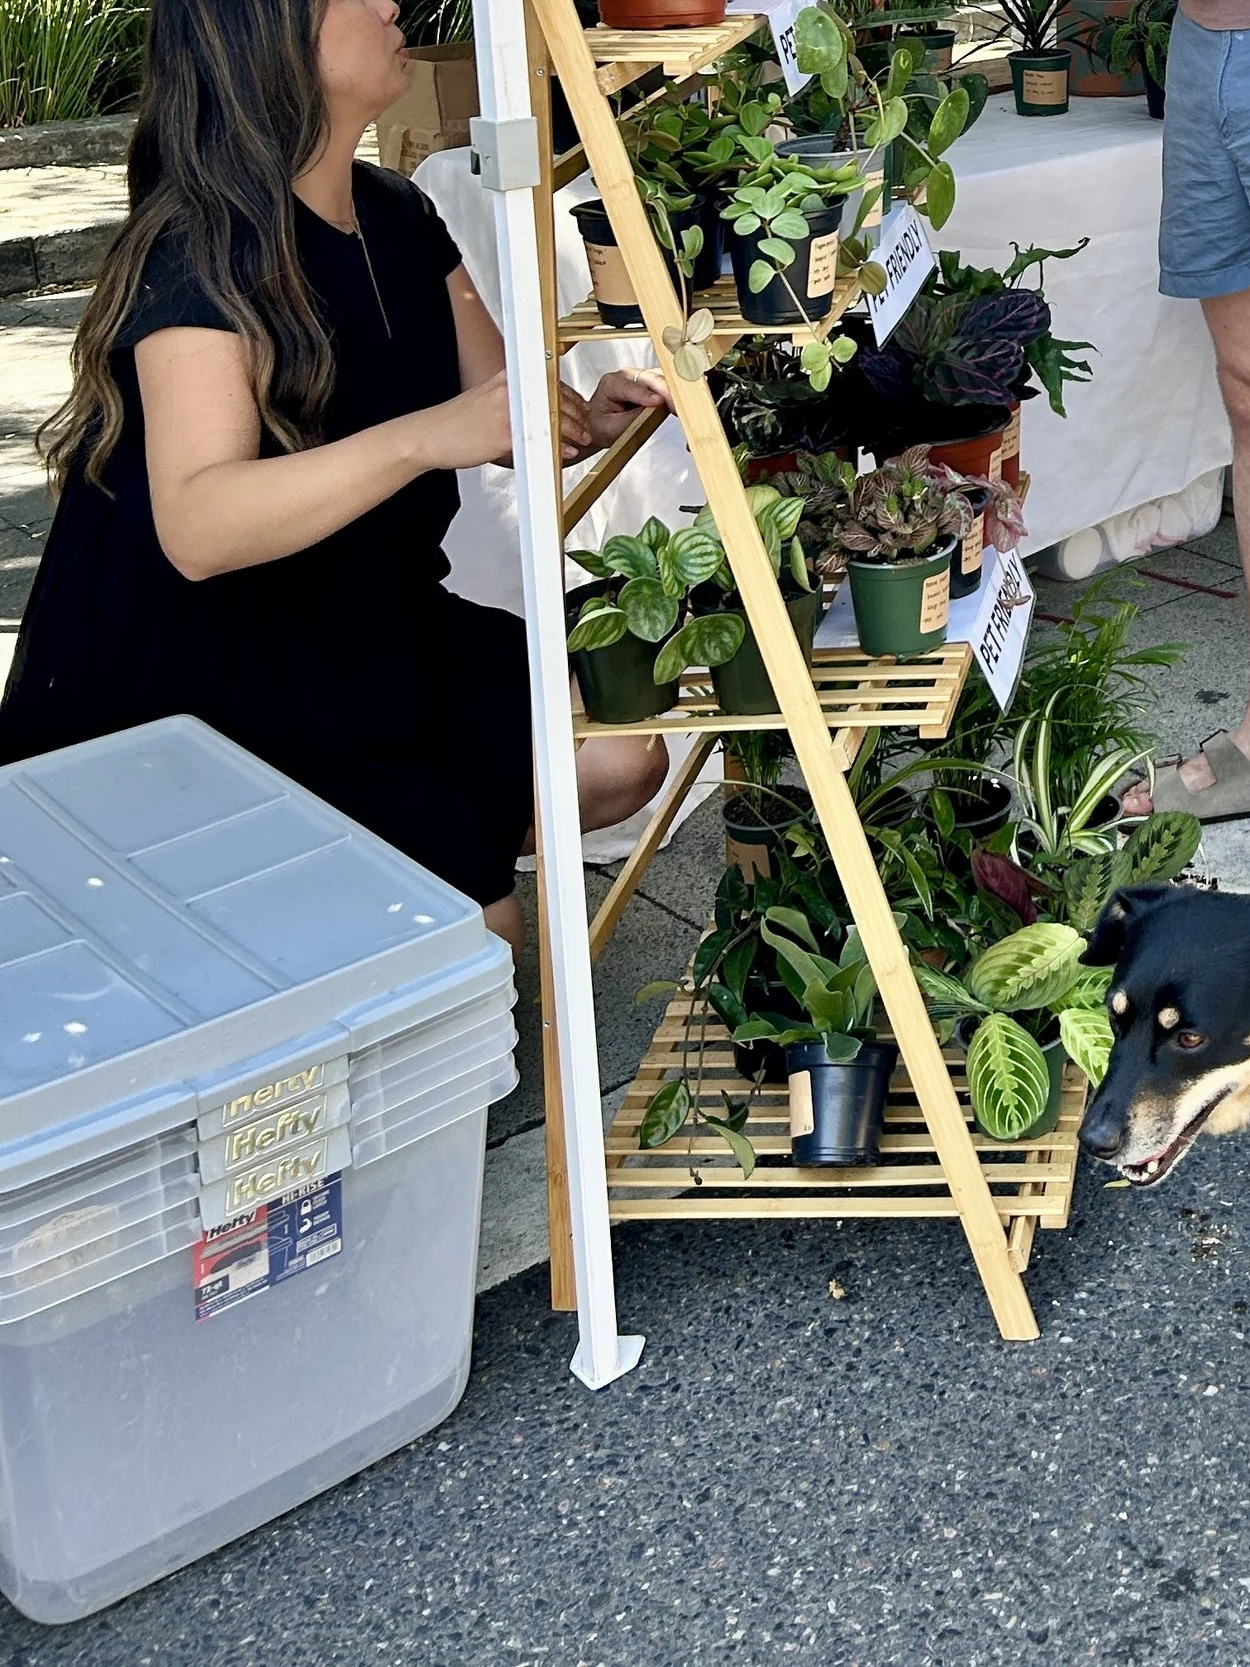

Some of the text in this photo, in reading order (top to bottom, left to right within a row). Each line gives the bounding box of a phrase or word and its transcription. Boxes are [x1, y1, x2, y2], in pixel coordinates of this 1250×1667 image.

[778, 25, 797, 65] PE
[885, 219, 923, 290] FRIENDLY
[979, 621, 1002, 675] PET
[232, 1105, 322, 1161] Hefty
[233, 1149, 322, 1206] Hefty
[282, 1179, 326, 1205] HI-RISE
[208, 1210, 256, 1240] Hefty
